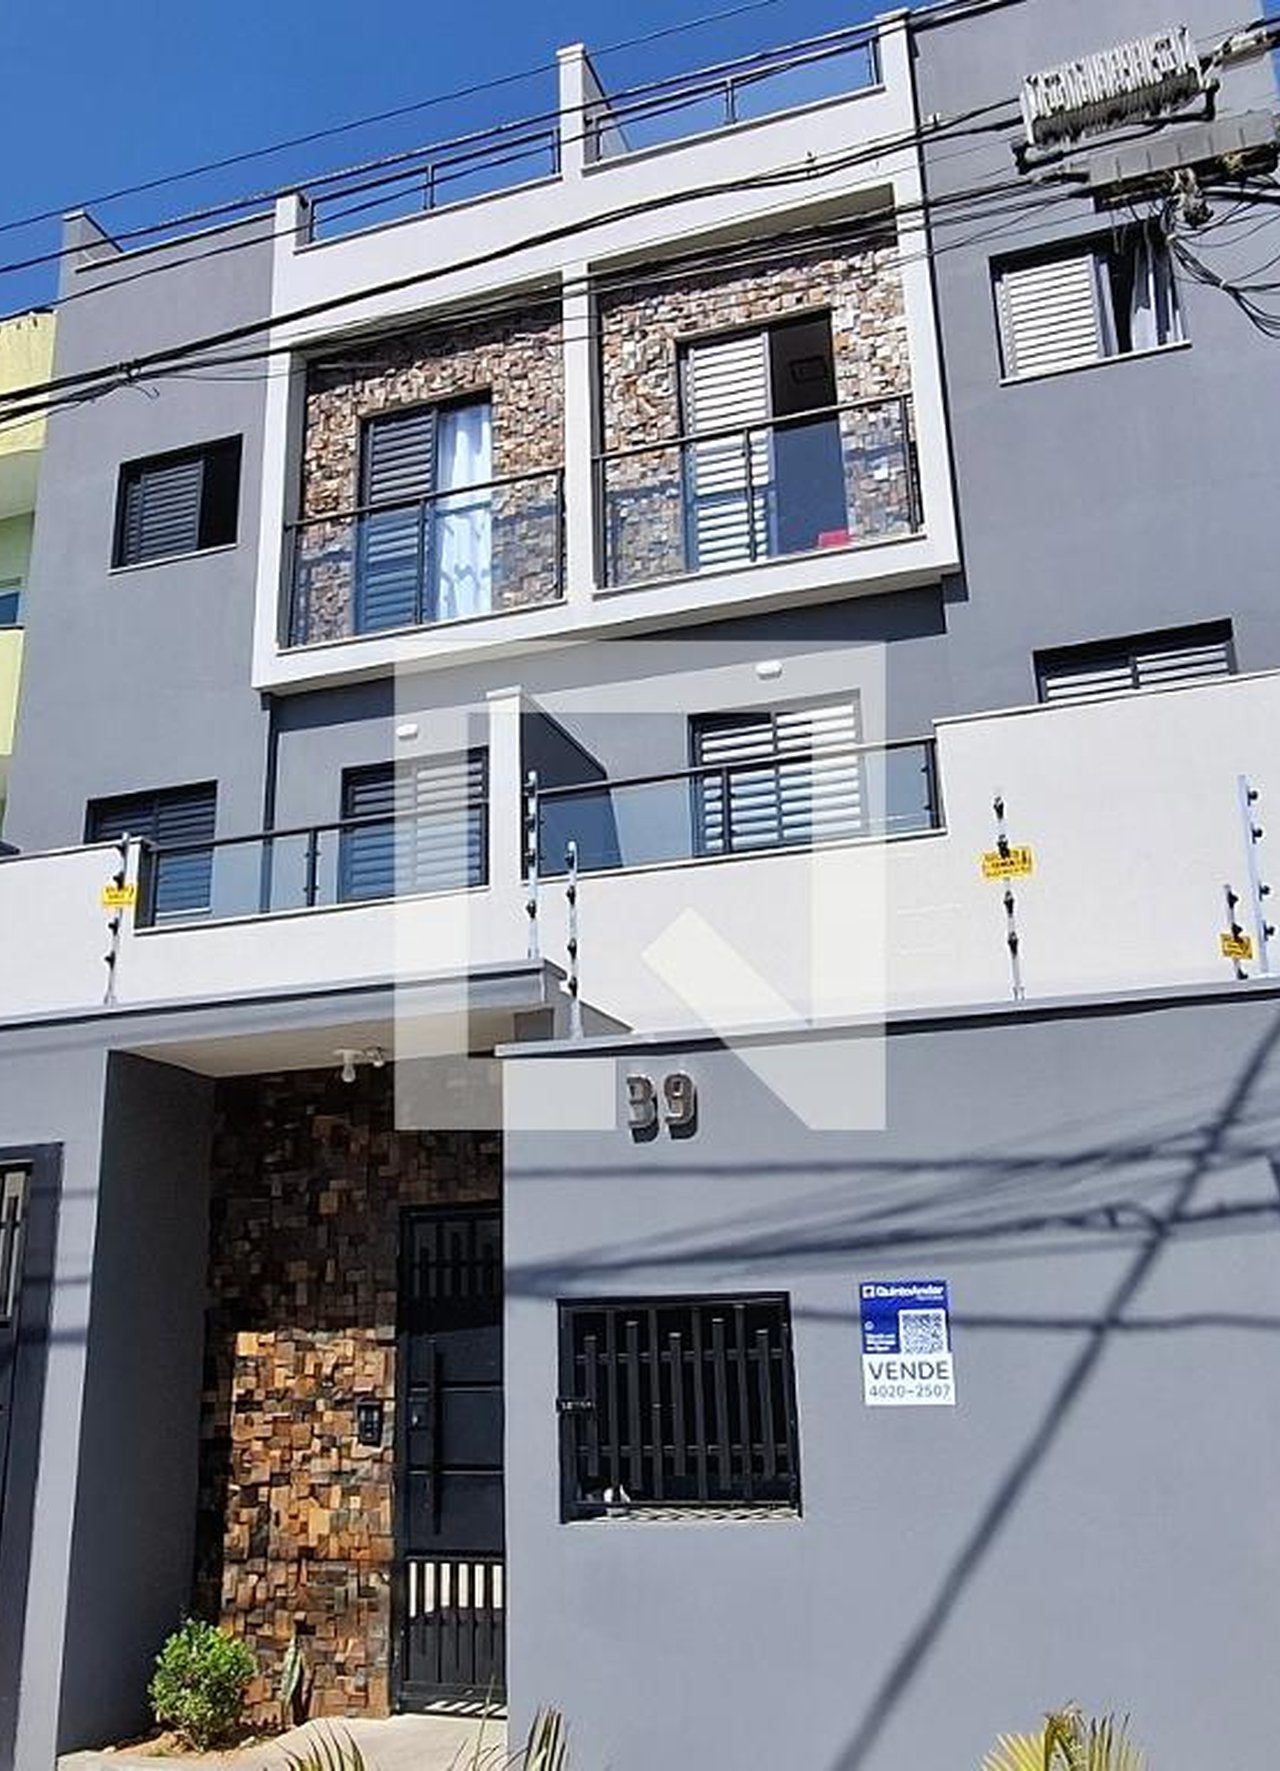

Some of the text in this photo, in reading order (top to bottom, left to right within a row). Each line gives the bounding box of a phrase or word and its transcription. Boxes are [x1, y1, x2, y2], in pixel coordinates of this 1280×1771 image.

[626, 1073, 695, 1133] 39
[868, 1361, 950, 1381] VENDE
[869, 1384, 951, 1399] 4020-2507
